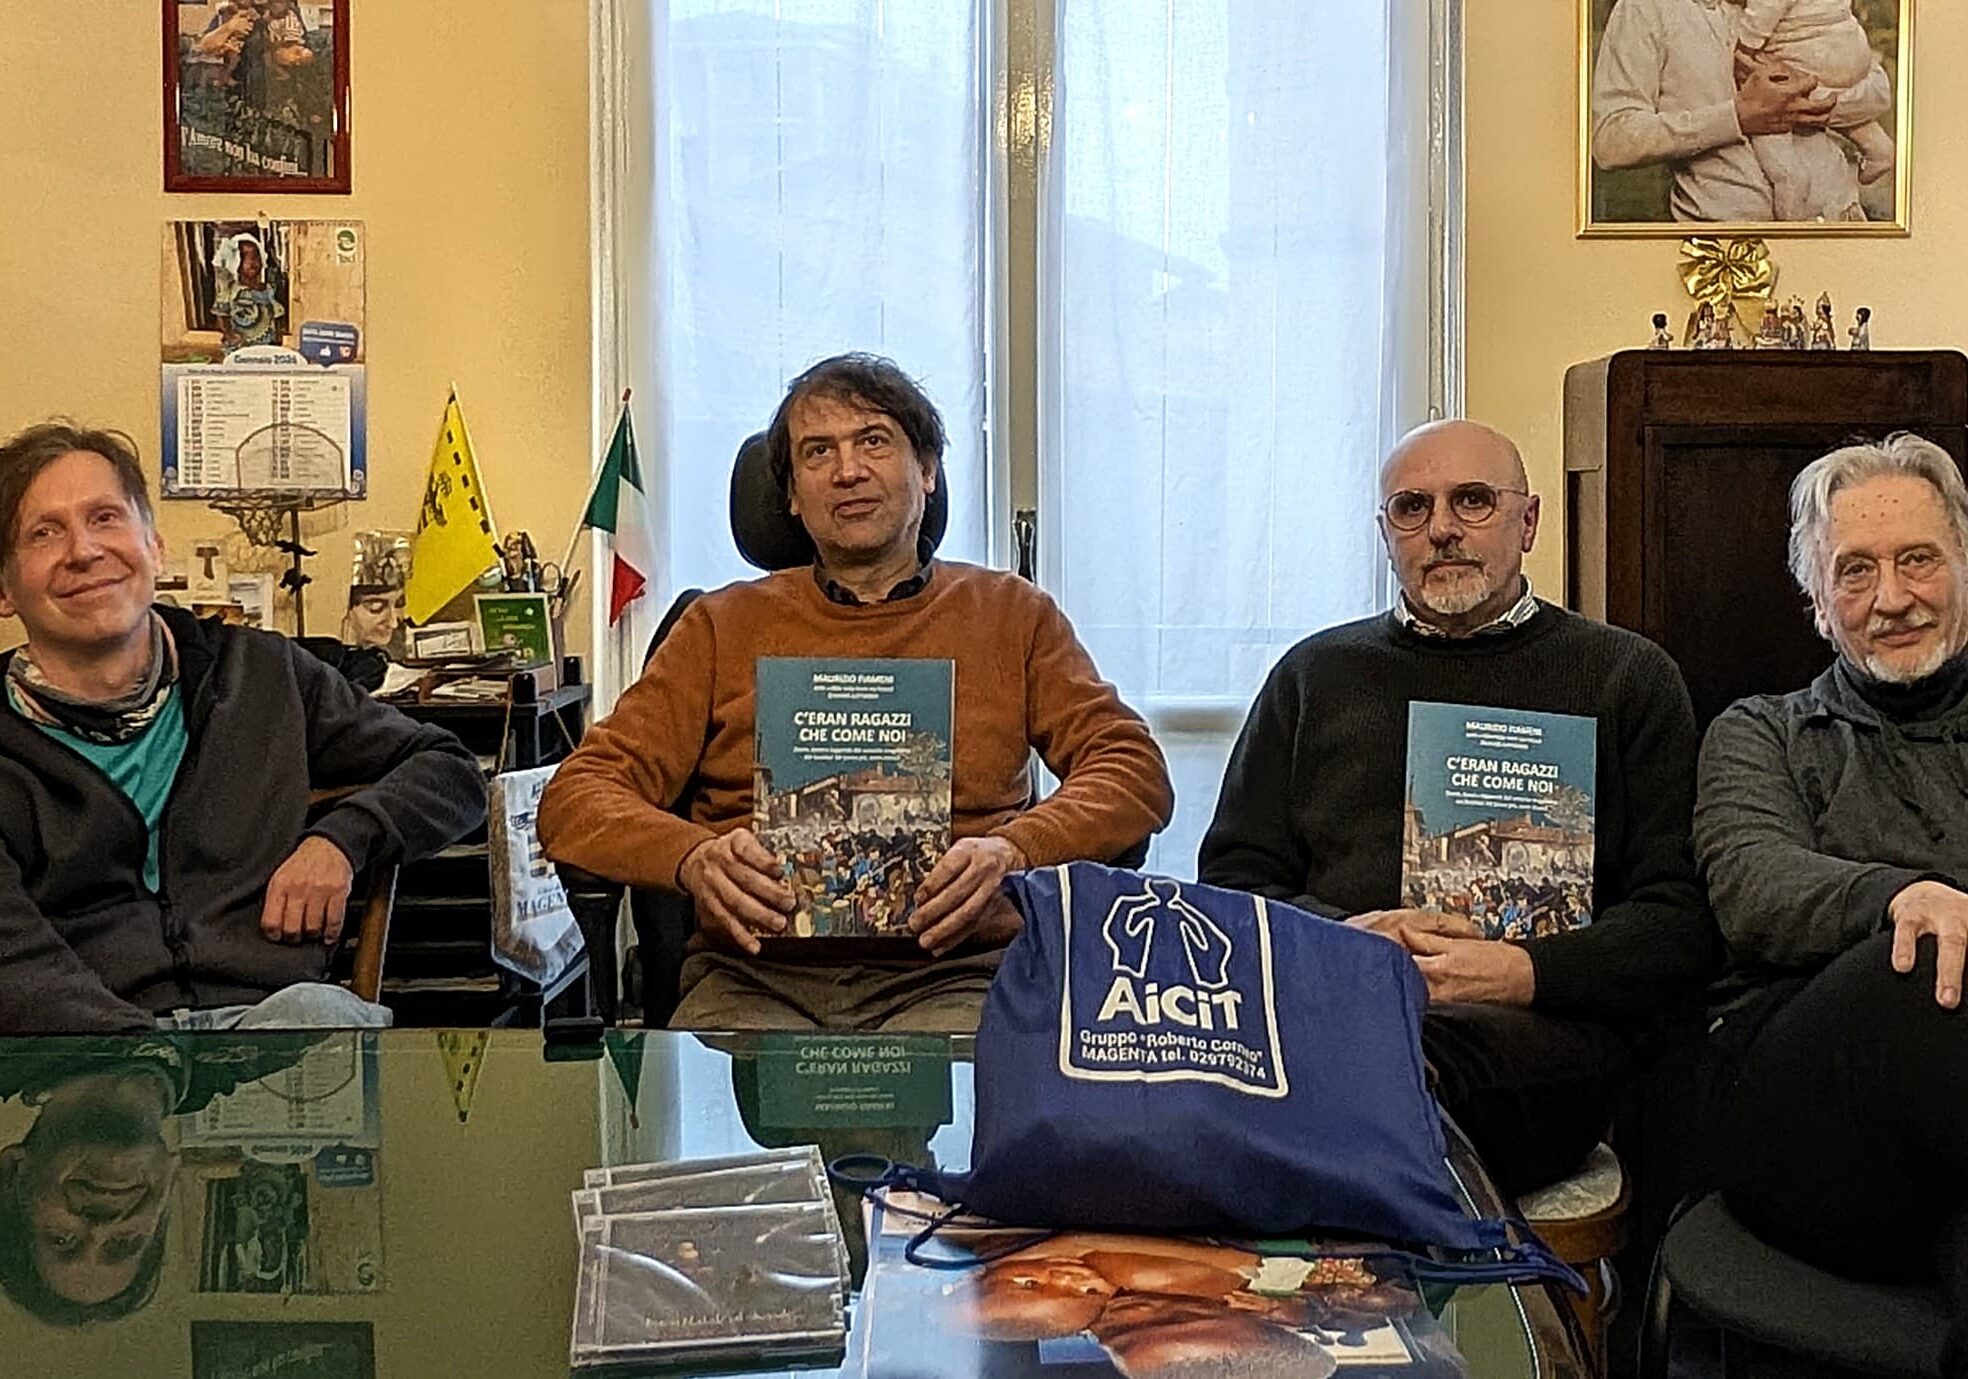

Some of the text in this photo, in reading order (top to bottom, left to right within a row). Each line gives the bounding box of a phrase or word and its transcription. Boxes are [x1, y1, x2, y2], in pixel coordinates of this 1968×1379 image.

[794, 711, 912, 727] C'ERAN RAGAZZI
[799, 728, 906, 743] CHE COME NOI
[1446, 756, 1559, 779] C'ERAN RAGAZZI
[1451, 772, 1554, 794] CHE COME NOI
[1079, 1029, 1137, 1047] Gruppo
[1081, 1045, 1158, 1064] MAGENTA
[1160, 1049, 1187, 1062] tel.
